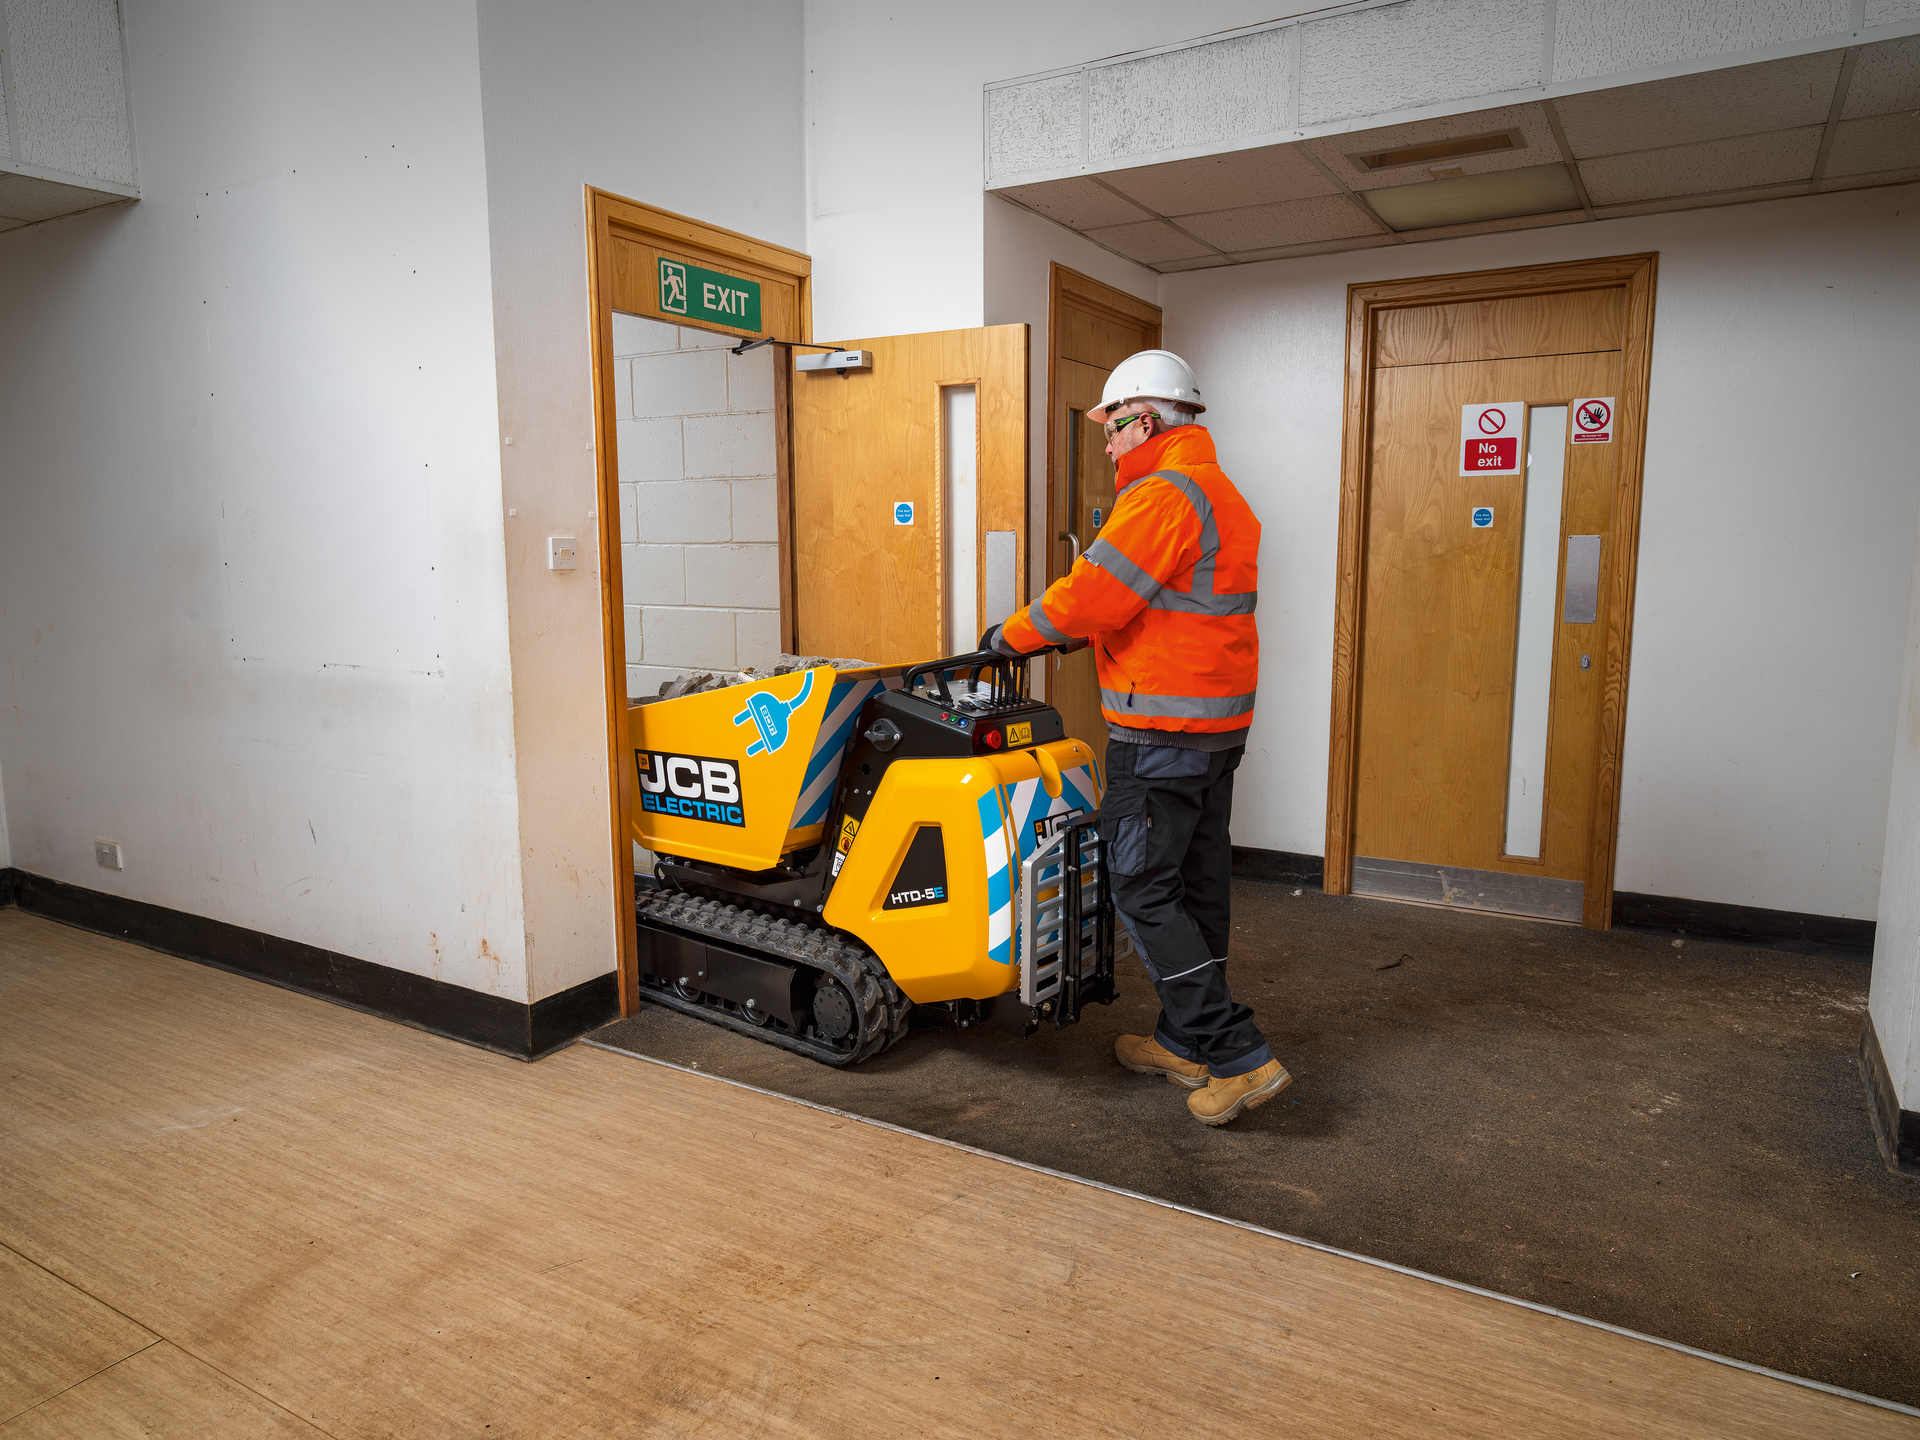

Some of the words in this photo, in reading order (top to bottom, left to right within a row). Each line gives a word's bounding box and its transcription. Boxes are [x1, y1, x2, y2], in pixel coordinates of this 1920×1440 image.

[703, 282, 749, 317] EXIT
[1477, 456, 1502, 467] exit
[1478, 442, 1498, 454] No
[760, 704, 778, 736] JCB
[640, 755, 739, 804] JCB
[642, 793, 743, 824] ELECTRIC
[891, 886, 945, 905] HTD-5E
